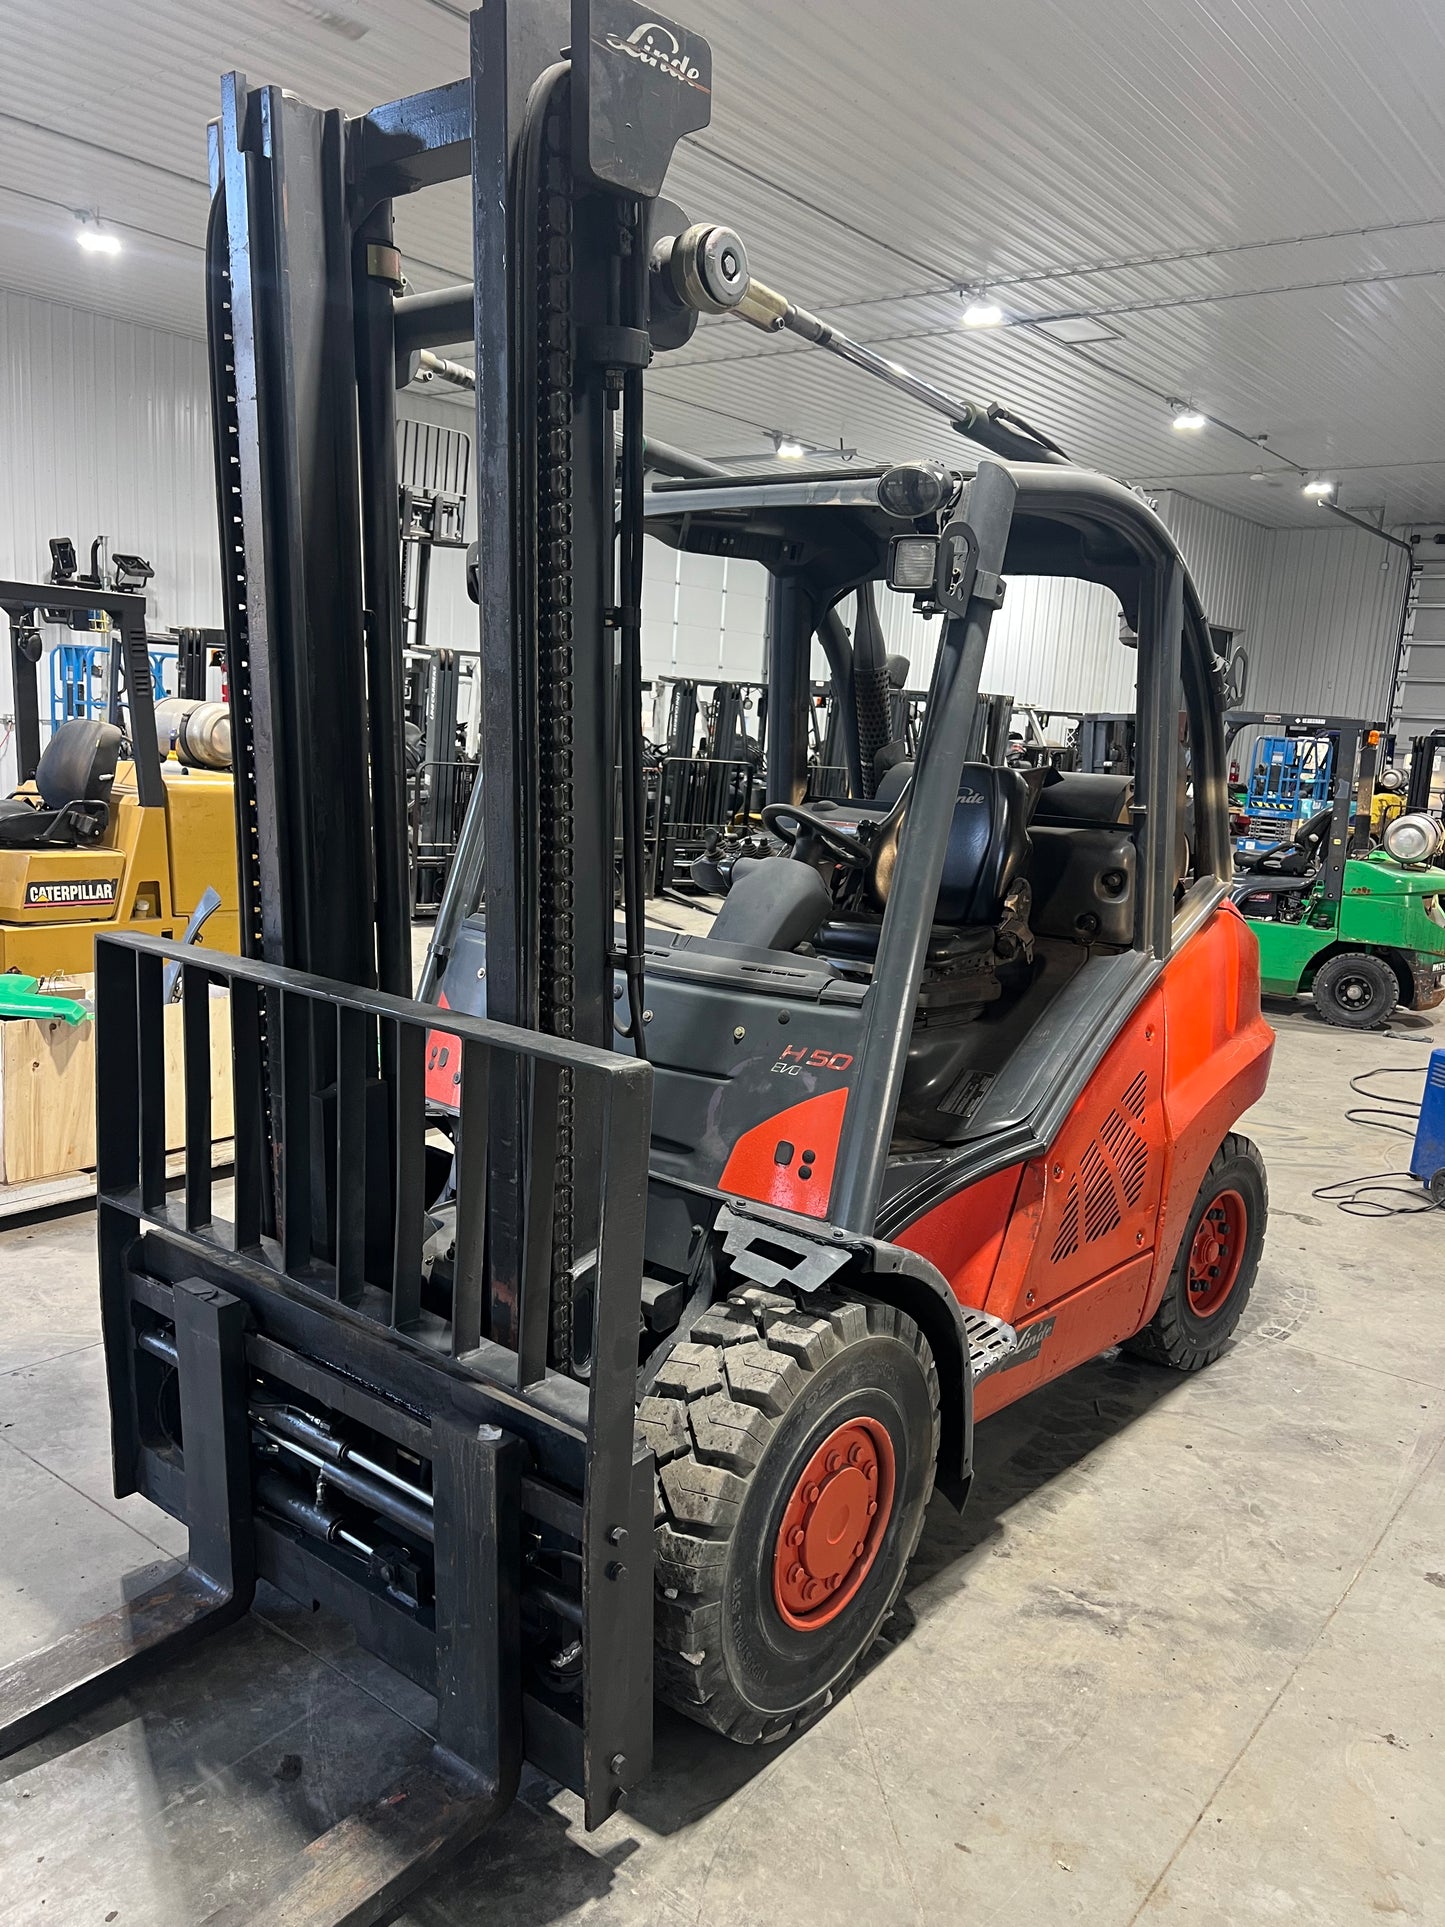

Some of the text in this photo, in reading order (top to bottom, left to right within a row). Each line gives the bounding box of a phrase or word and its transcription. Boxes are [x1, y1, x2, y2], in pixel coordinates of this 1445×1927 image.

[606, 22, 700, 87] Linde
[956, 786, 985, 804] nde
[29, 883, 113, 902] CATERPILLAR
[770, 1061, 803, 1076] EVO
[1013, 1322, 1052, 1355] Linde
